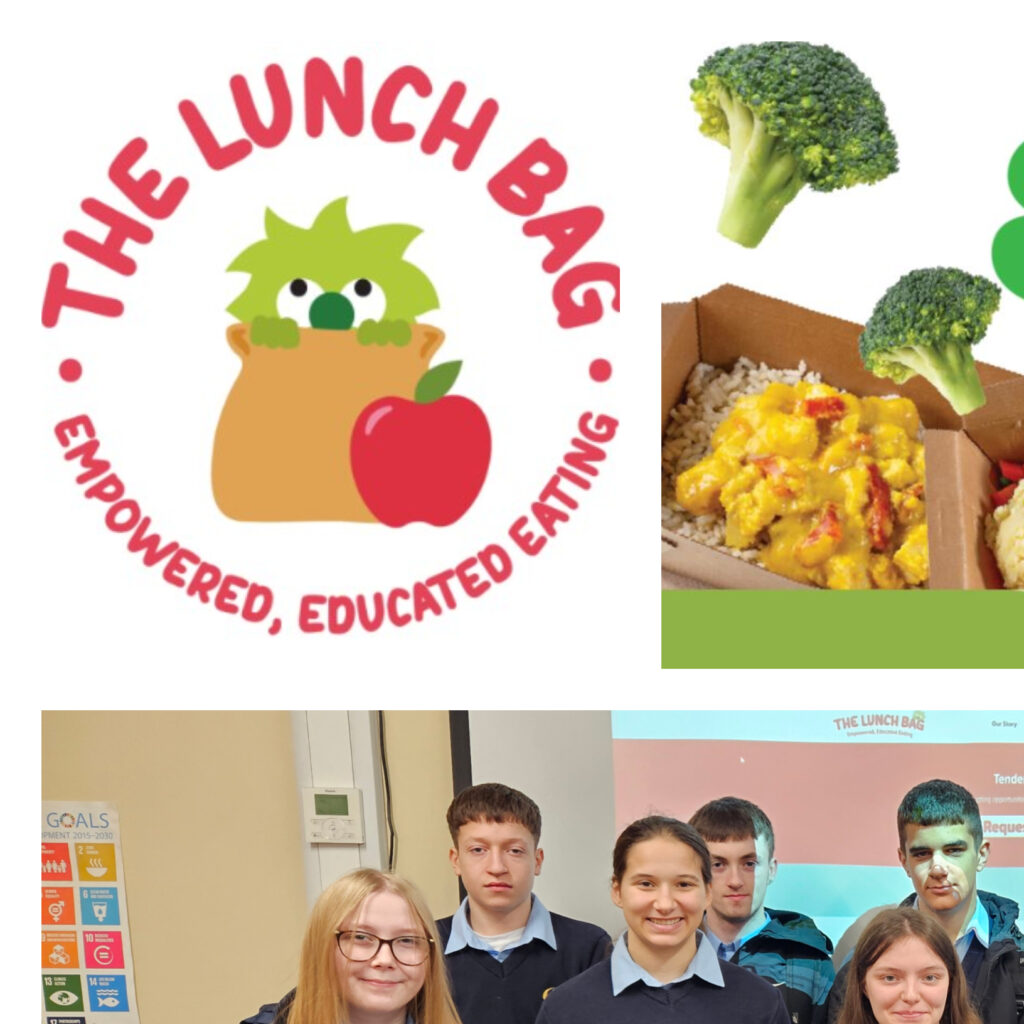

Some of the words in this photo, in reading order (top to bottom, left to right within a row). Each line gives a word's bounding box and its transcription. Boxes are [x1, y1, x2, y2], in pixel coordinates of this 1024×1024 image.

[41, 137, 189, 328] THE
[178, 56, 499, 171] LUNCH
[487, 137, 620, 329] BAG
[54, 414, 281, 635] EMPOWERED,
[299, 543, 513, 634] EDUCATED
[508, 411, 619, 556] EATING
[833, 716, 858, 730] THE
[861, 714, 899, 727] LUNCH
[901, 715, 925, 731] BAG
[46, 812, 110, 829] GOALS
[42, 832, 70, 840] PMENT
[78, 845, 84, 855] 2
[85, 933, 94, 943] 10
[44, 977, 53, 986] 13
[89, 977, 98, 986] 14
